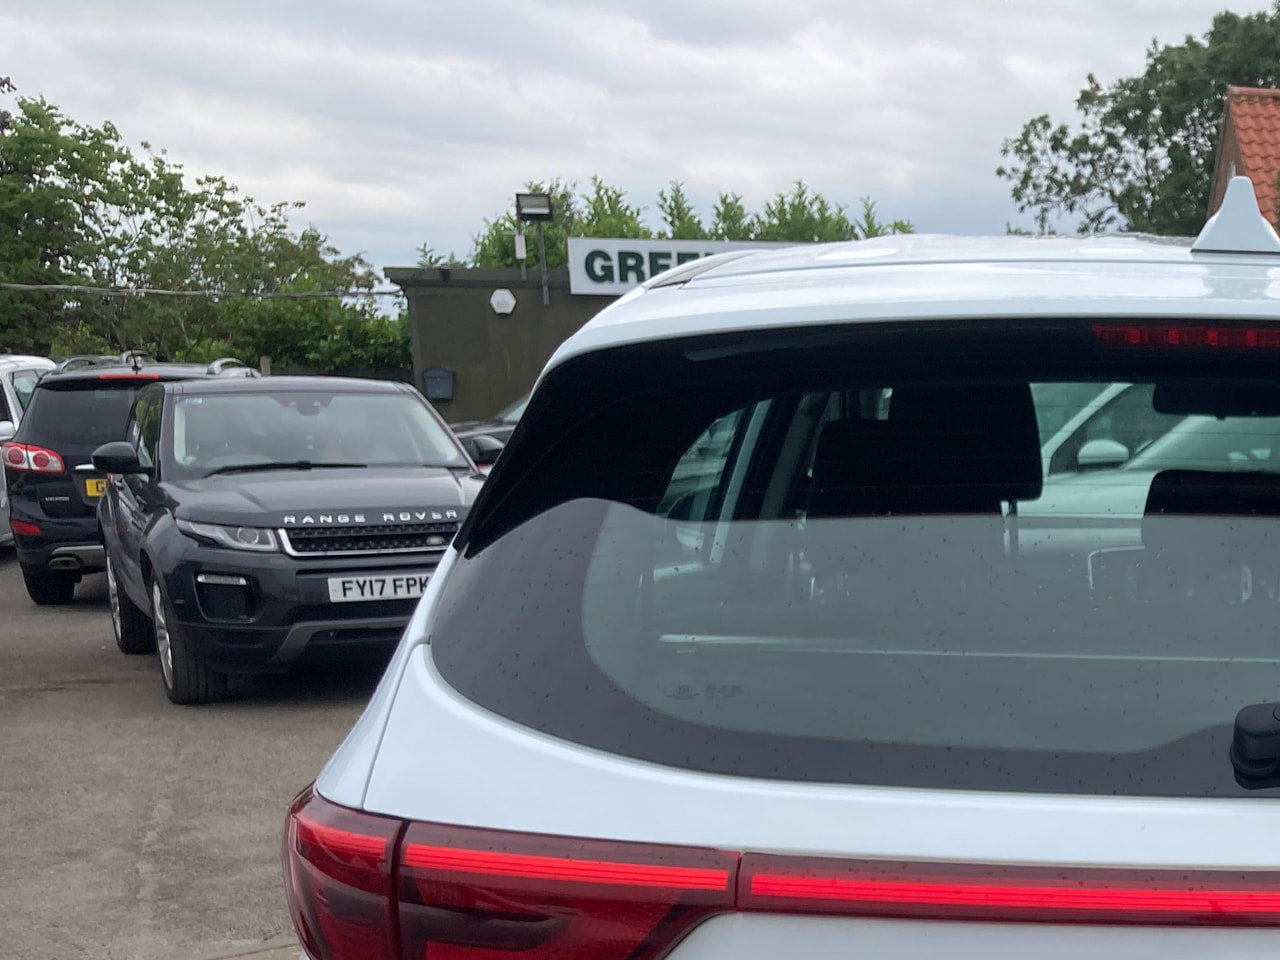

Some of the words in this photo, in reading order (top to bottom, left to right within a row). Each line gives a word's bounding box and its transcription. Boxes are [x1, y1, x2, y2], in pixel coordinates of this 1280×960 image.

[584, 249, 714, 284] GRE
[284, 513, 366, 525] RANGE
[382, 509, 458, 523] ROVER
[341, 578, 387, 599] FY17
